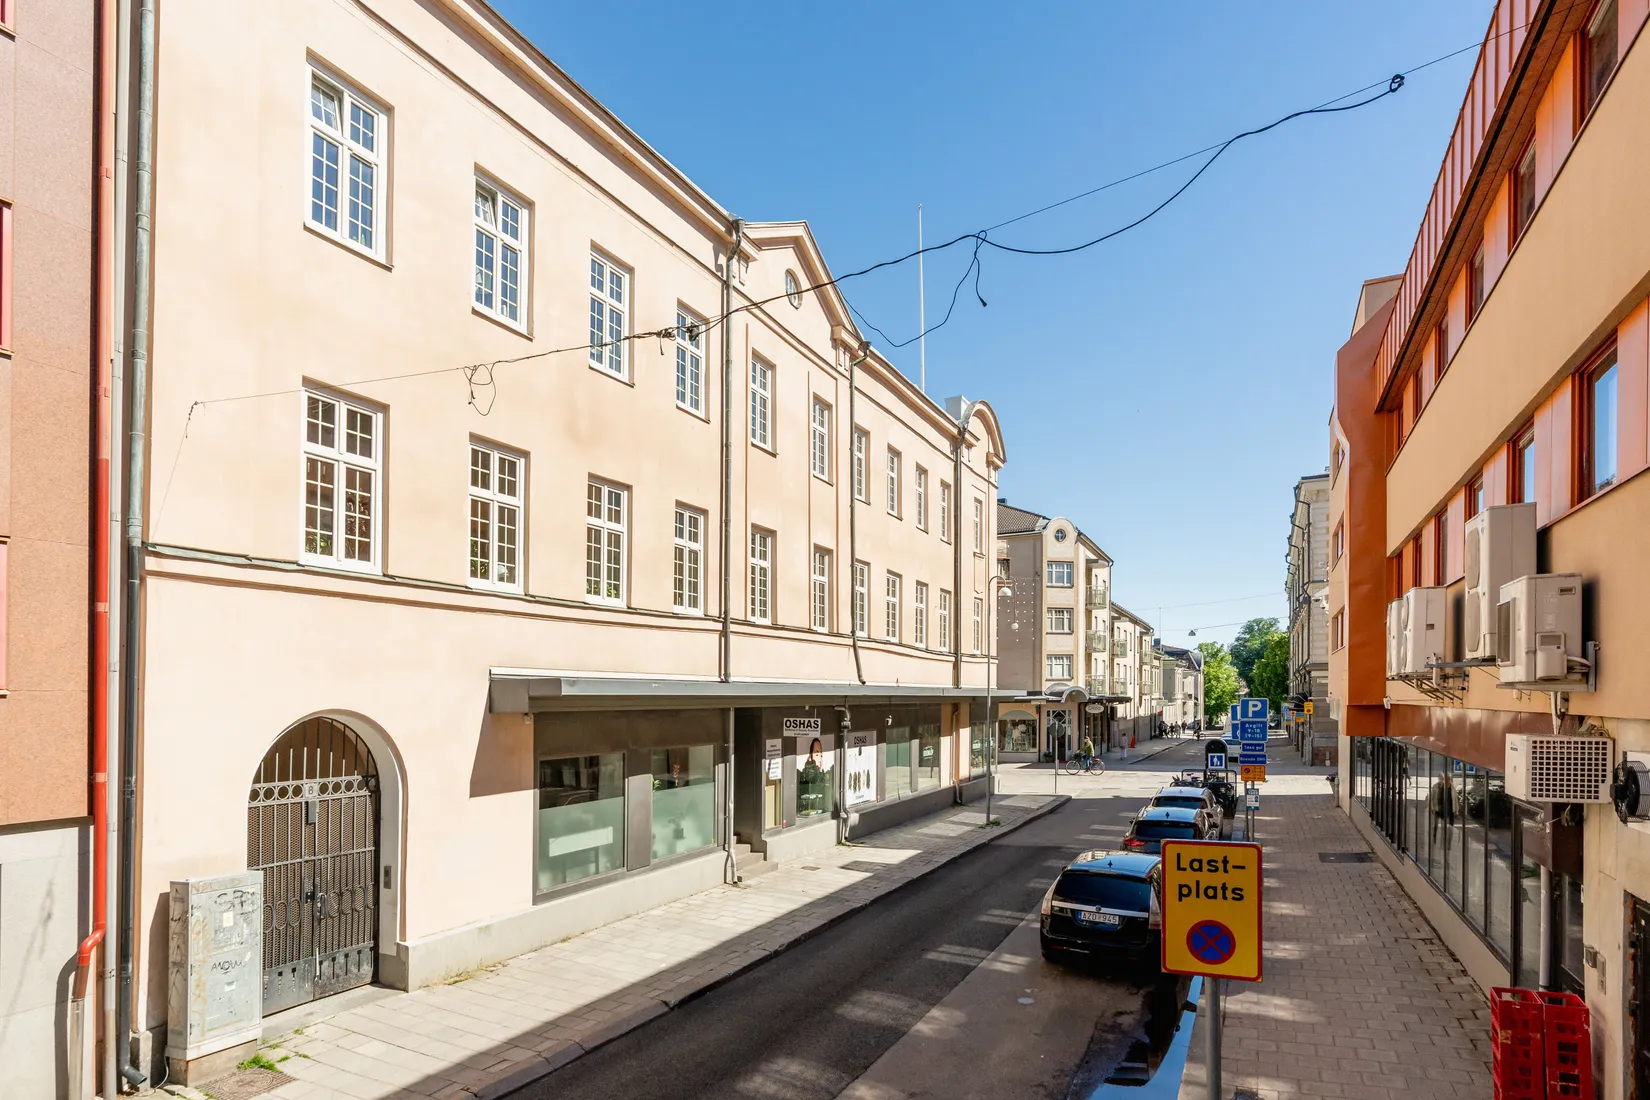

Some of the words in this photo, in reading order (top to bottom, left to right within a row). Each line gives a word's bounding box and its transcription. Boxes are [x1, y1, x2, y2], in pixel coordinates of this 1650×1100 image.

[1248, 700, 1262, 717] P
[784, 719, 819, 729] OSHAS
[853, 735, 867, 745] OSHAS
[1176, 852, 1246, 874] Last-
[1178, 880, 1245, 902] plats
[1102, 915, 1118, 923] 945
